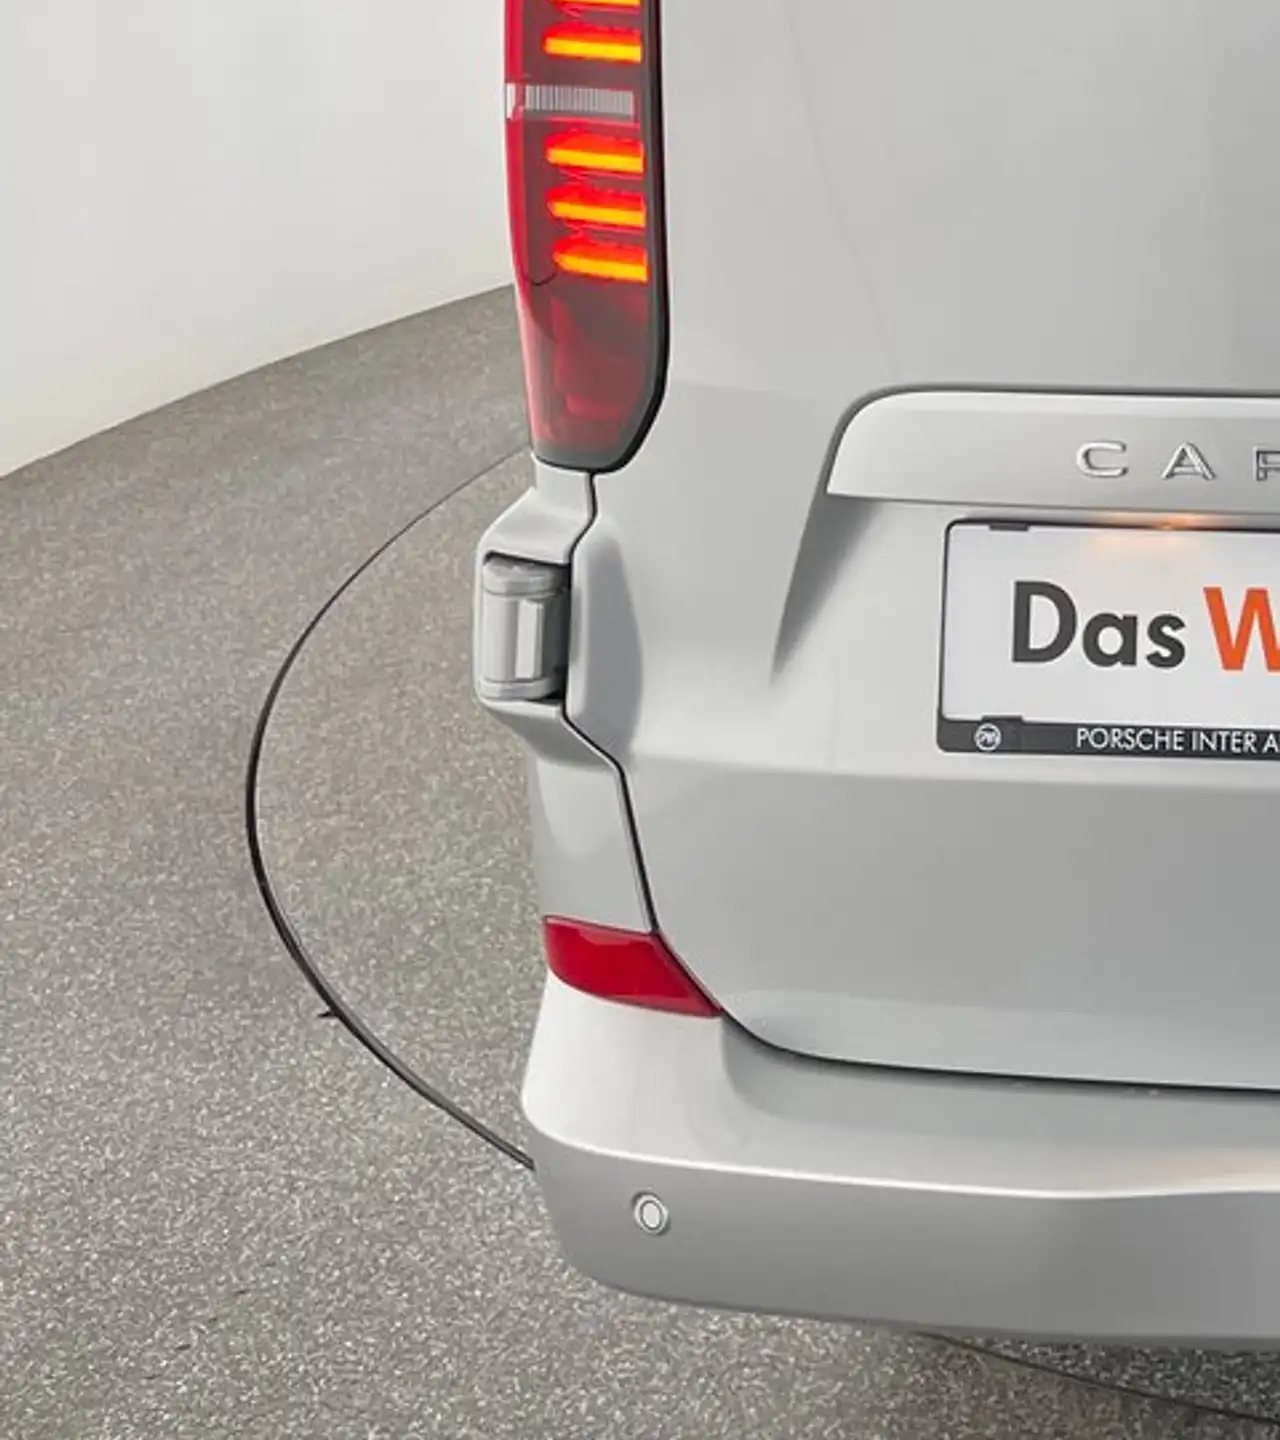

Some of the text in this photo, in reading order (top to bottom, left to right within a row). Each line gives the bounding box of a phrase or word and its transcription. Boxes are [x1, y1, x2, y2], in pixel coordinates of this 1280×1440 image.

[1011, 580, 1186, 669] Das
[1075, 727, 1184, 752] PORSCHE
[1191, 729, 1257, 754] INTER
